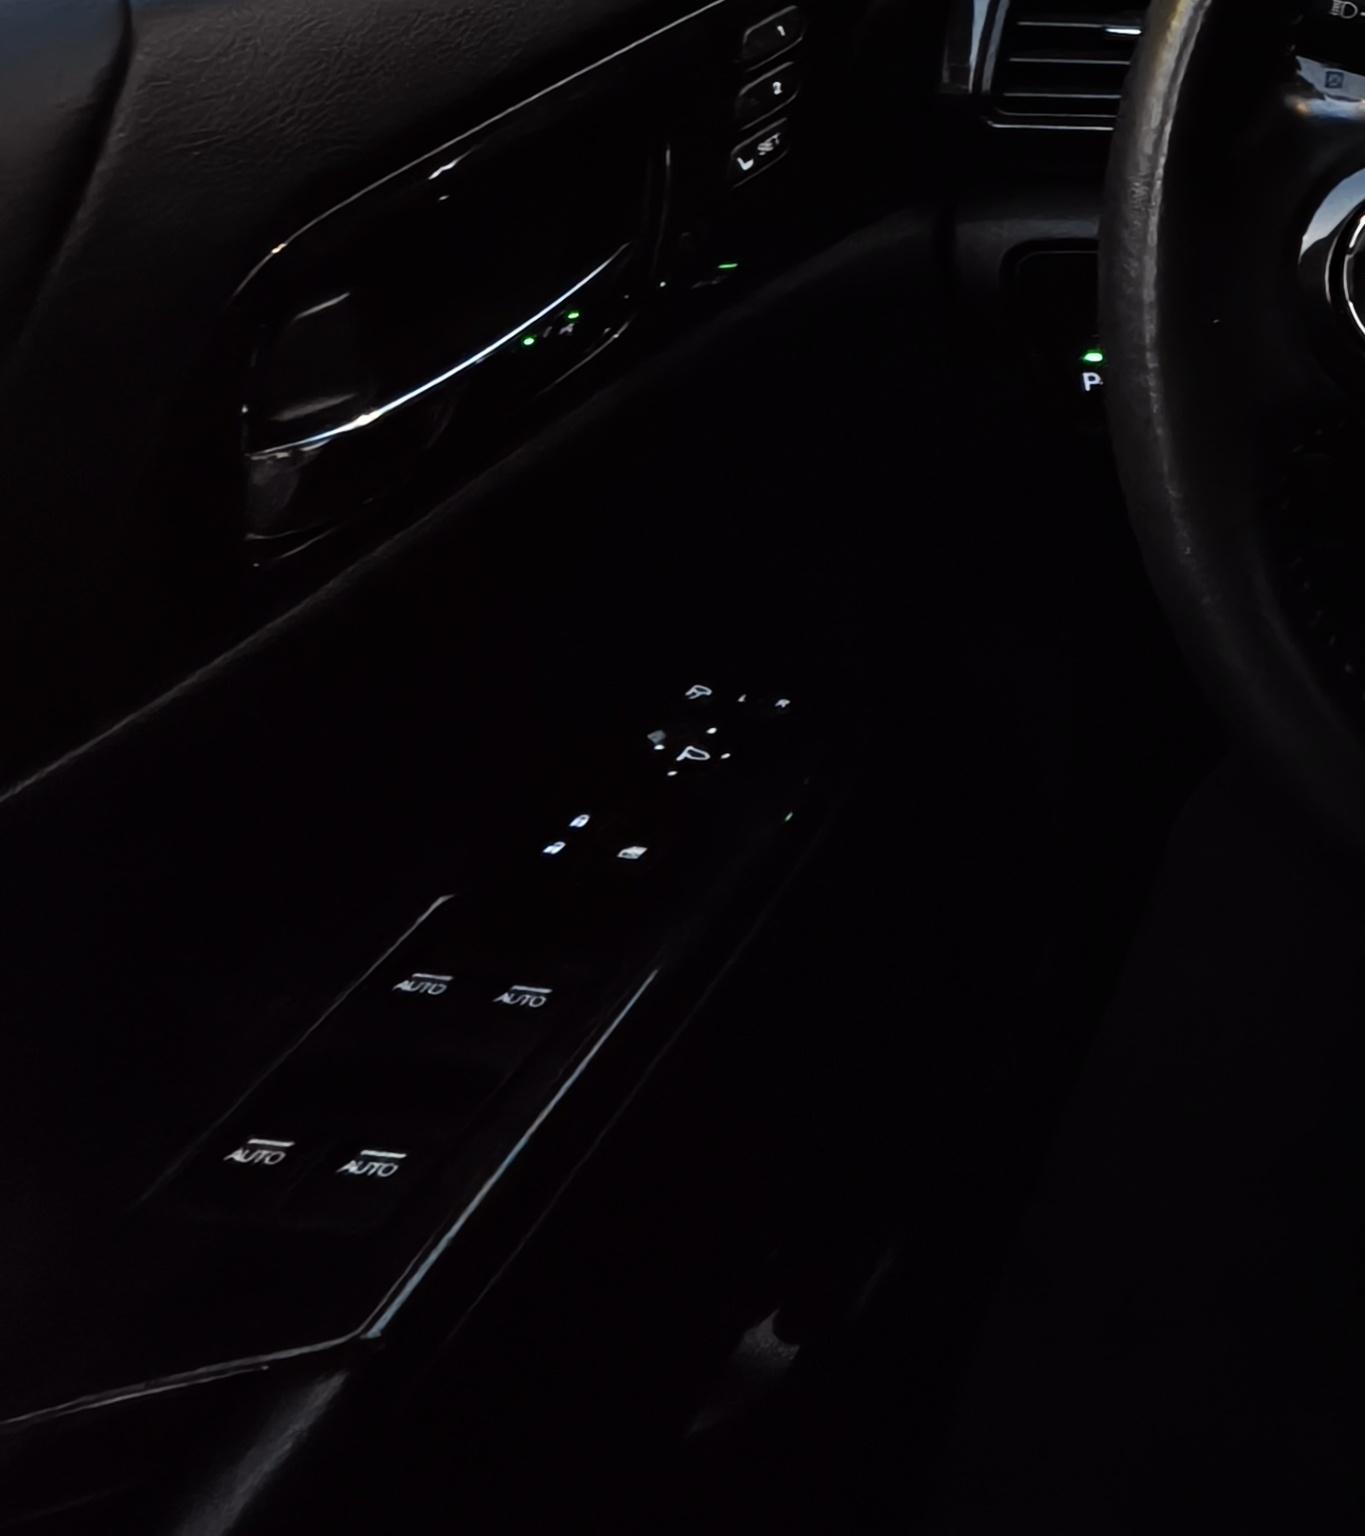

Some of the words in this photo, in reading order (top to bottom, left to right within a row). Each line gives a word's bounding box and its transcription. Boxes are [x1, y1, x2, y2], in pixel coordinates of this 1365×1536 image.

[393, 978, 447, 996] AUTO
[493, 991, 547, 1008] AUTO
[223, 1148, 287, 1166] AUTO
[337, 1160, 399, 1178] AUTO
